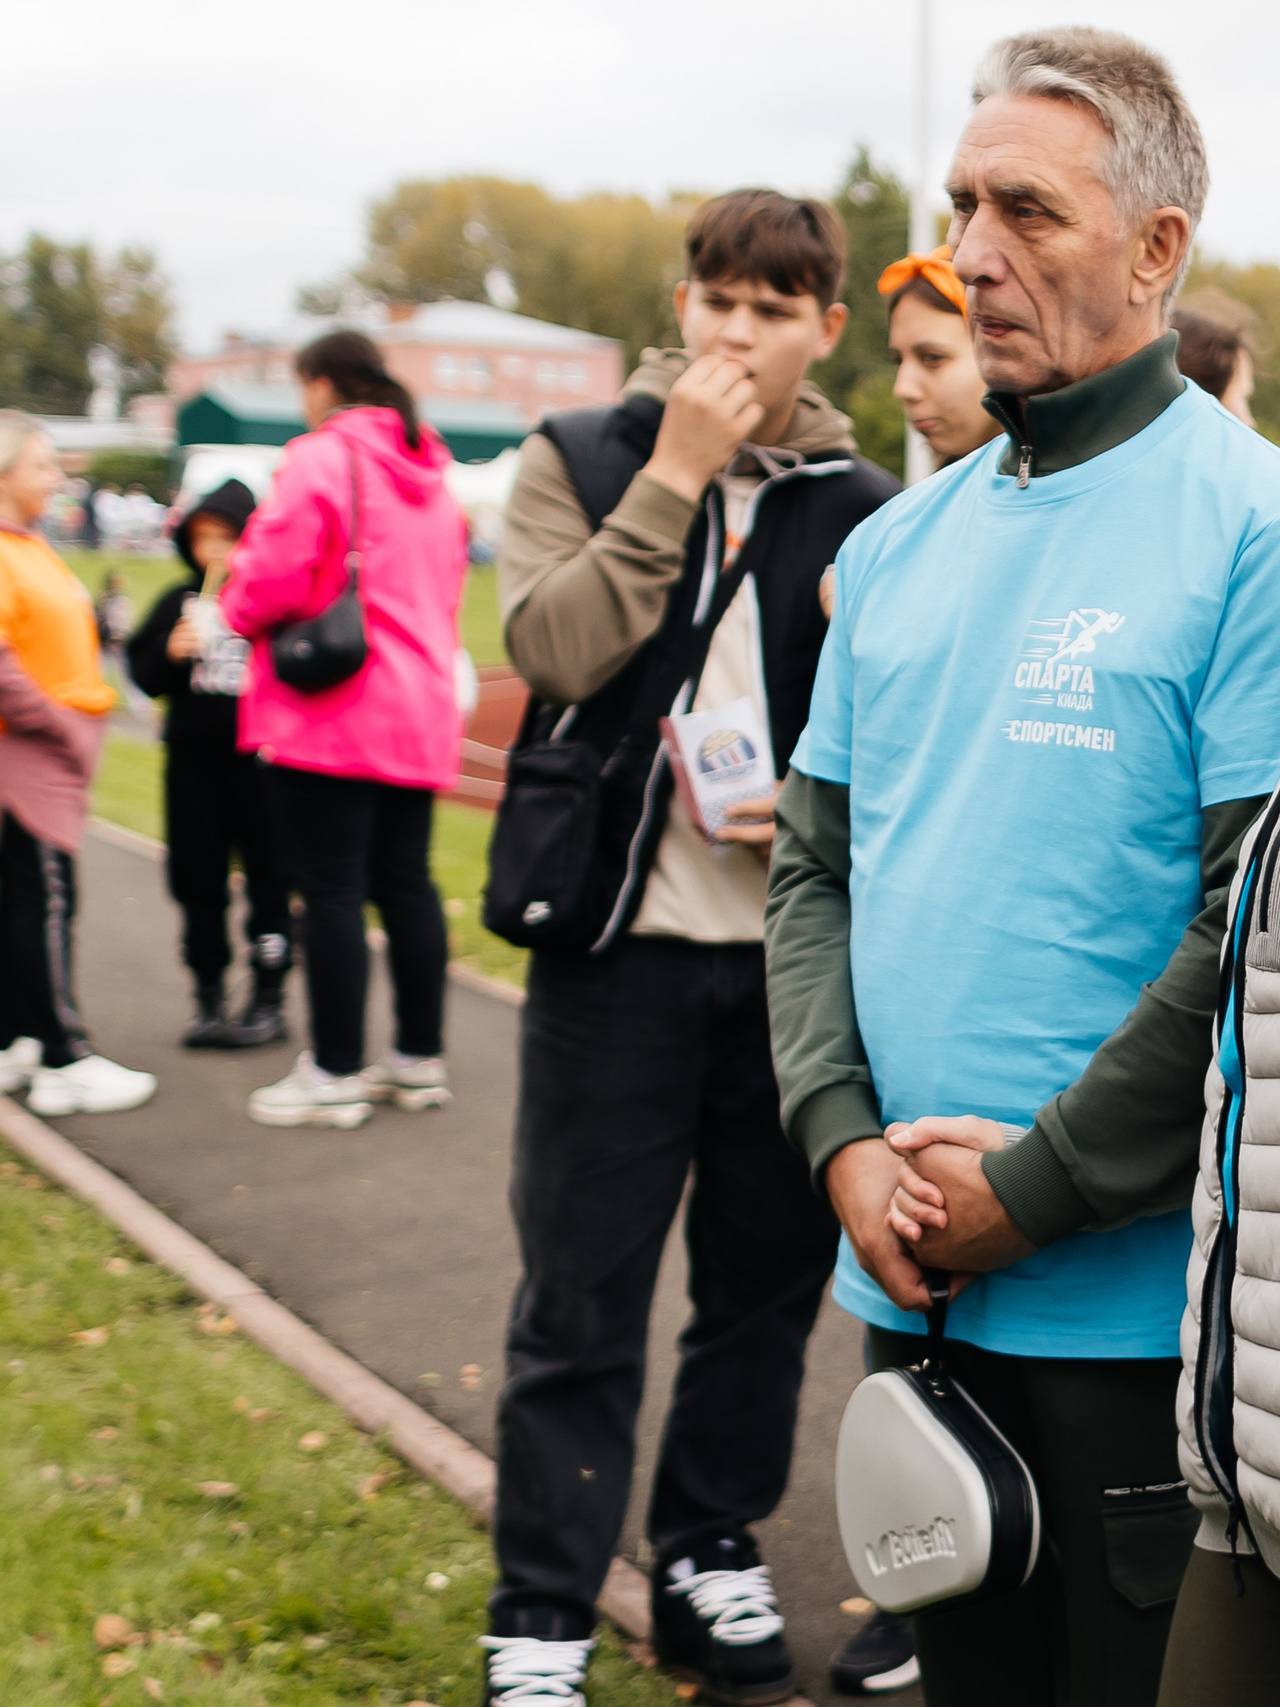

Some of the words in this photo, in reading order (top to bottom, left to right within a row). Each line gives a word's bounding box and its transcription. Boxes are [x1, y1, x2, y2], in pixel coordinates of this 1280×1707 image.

[1014, 661, 1095, 694] СПАРТА
[1056, 691, 1093, 712] КИАДА
[1008, 719, 1115, 752] СПОРТСМЕН
